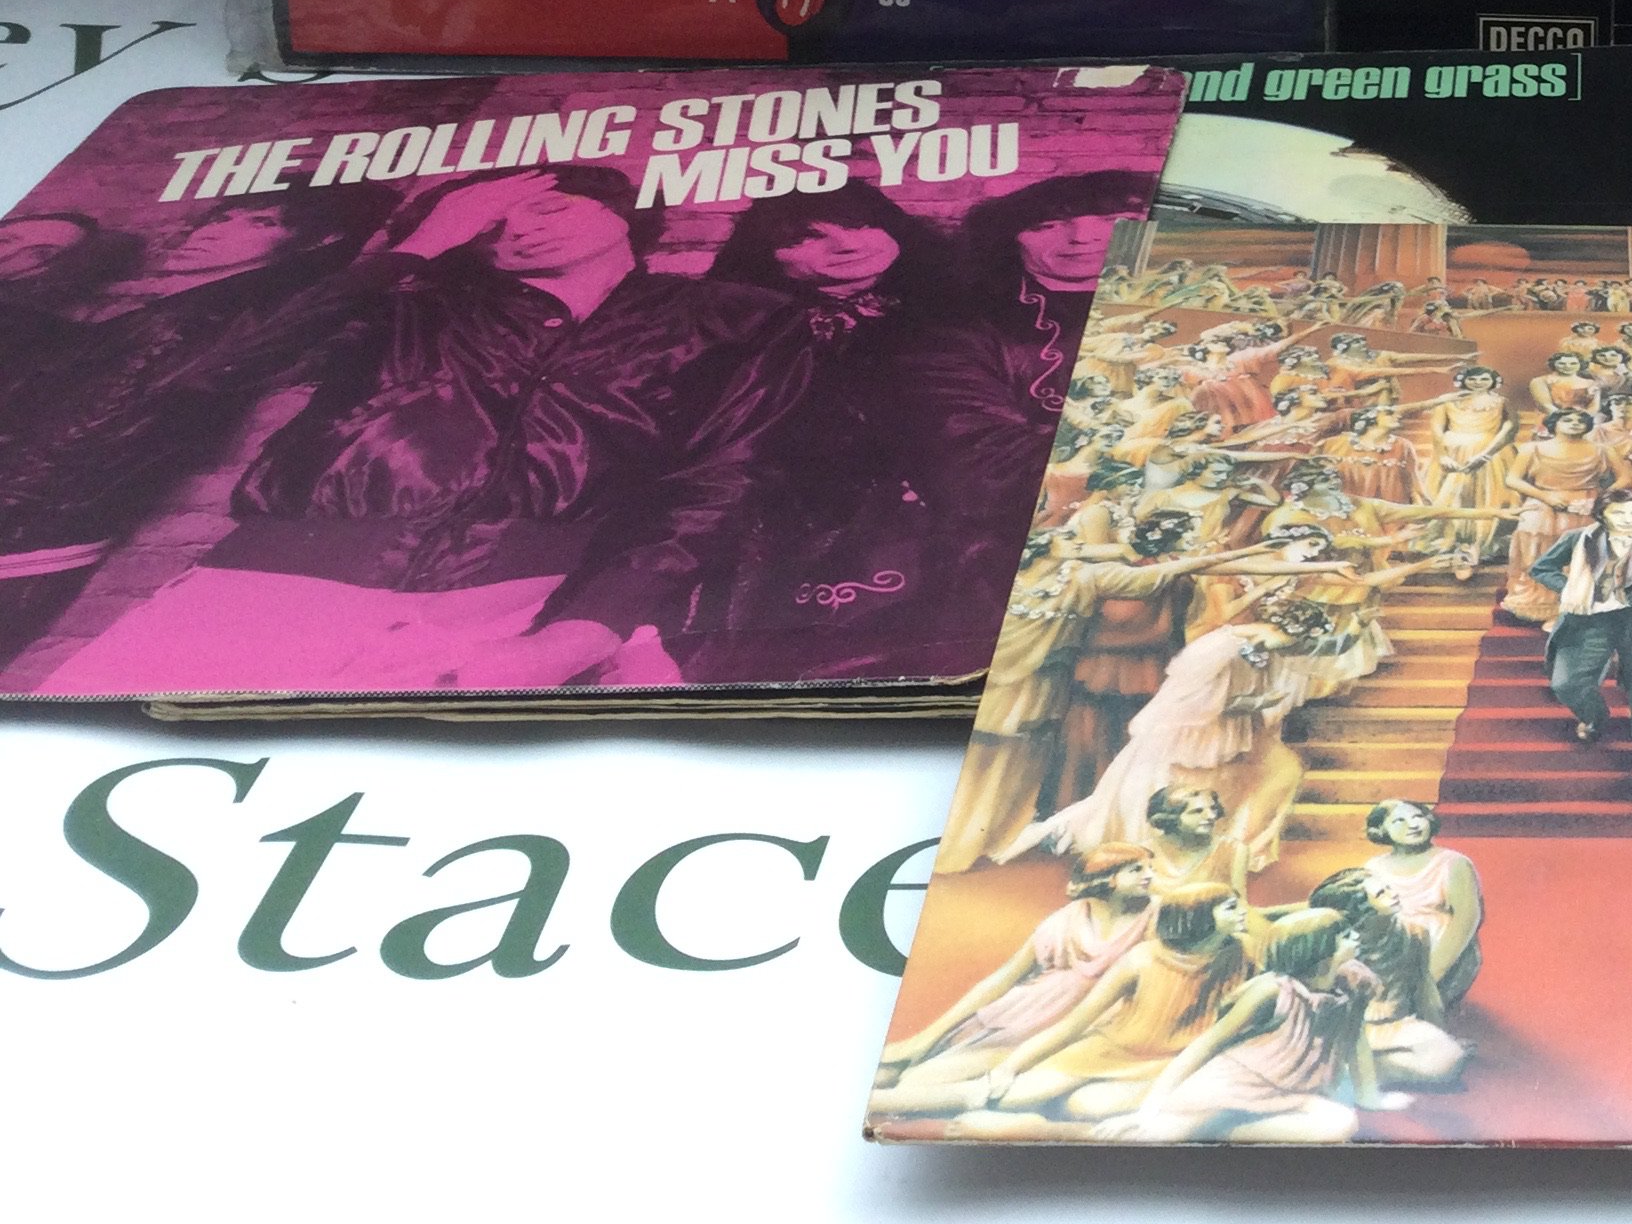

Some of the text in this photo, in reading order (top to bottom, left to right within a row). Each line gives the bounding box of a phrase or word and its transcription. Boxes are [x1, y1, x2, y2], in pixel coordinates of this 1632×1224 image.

[1490, 26, 1584, 52] DECCA
[1263, 64, 1412, 102] green
[157, 80, 943, 204] THE ROLLING STONES
[633, 123, 1019, 210] MISS YOU
